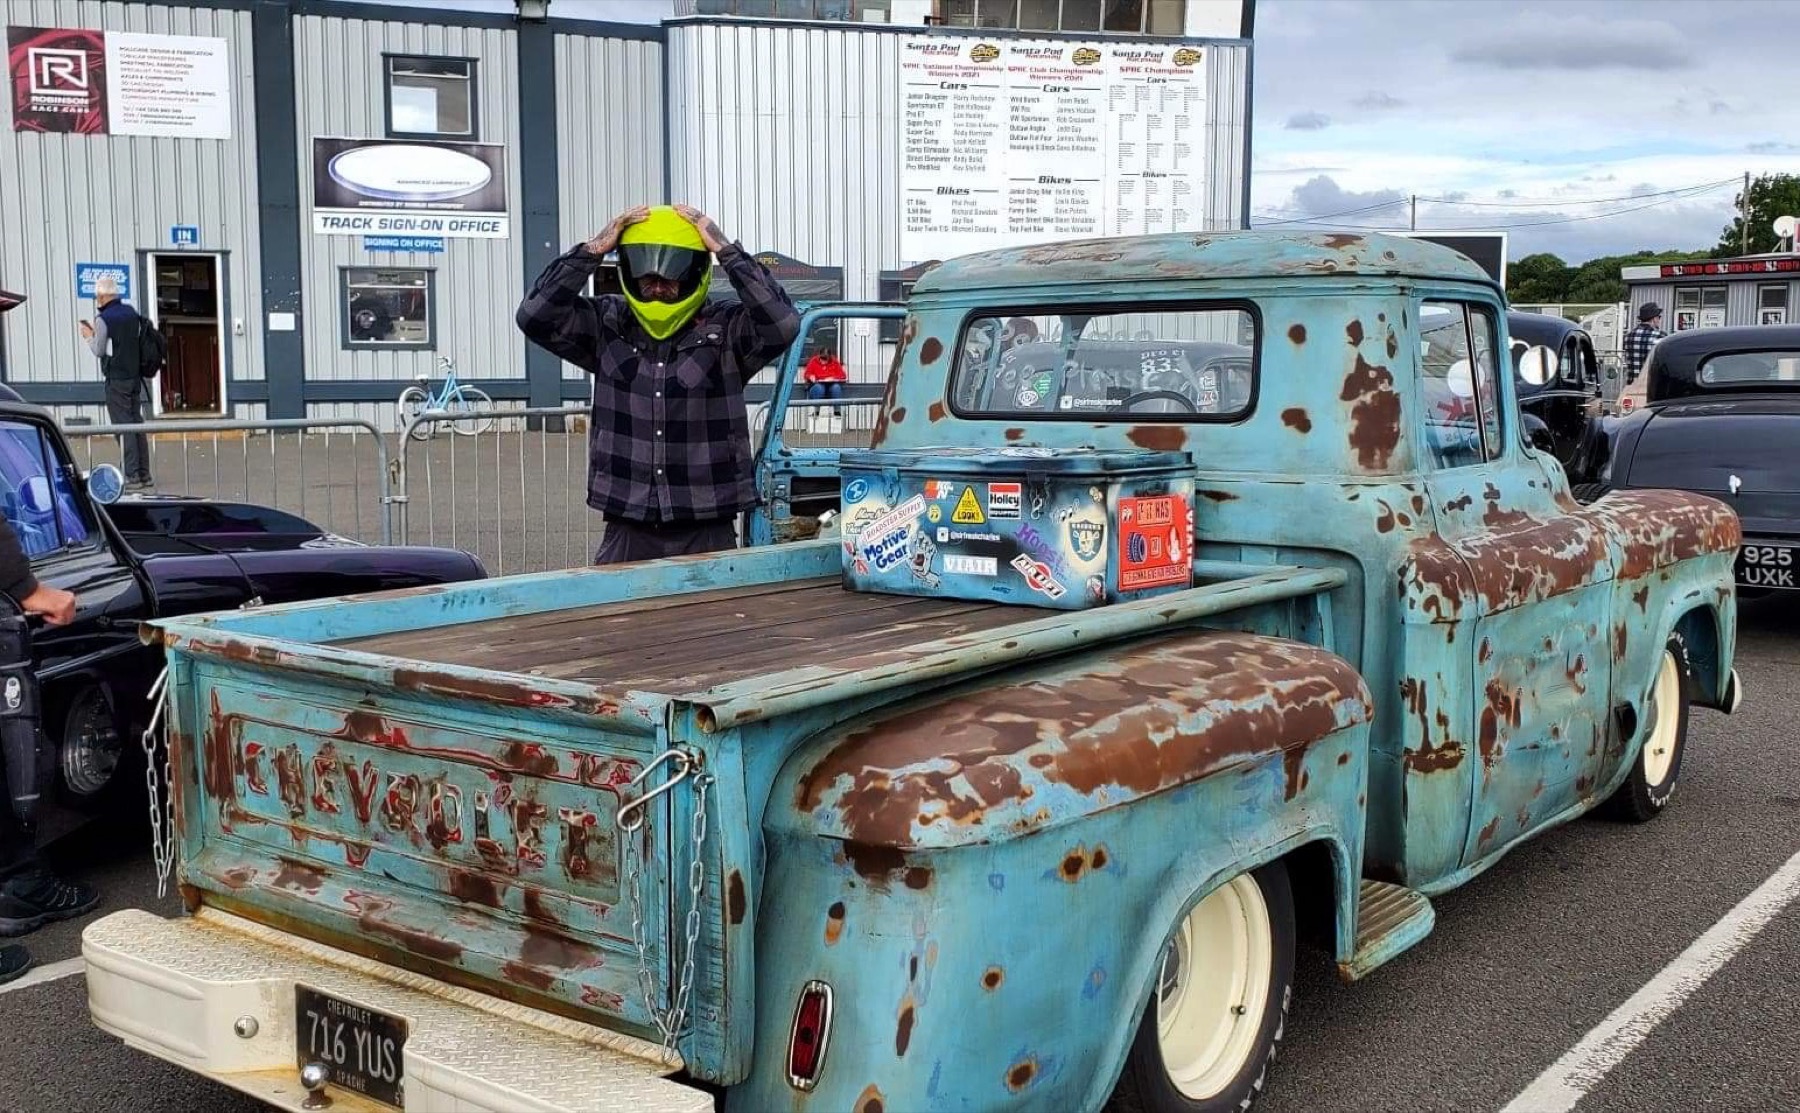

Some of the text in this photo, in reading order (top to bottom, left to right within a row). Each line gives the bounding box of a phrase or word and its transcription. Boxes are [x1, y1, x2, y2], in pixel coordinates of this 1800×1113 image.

[906, 43, 960, 52] Santa Pod
[940, 82, 968, 90] Cars
[1043, 84, 1070, 92] Cars
[31, 96, 89, 105] ROBINSON
[937, 186, 970, 195] Bikes
[322, 217, 500, 232] TRACK SIGN-ON OFFICE
[178, 230, 192, 241] IN
[366, 237, 442, 249] SIGNING ON OFFICE
[990, 493, 1019, 506] Holley
[1155, 501, 1170, 518] HAS
[866, 513, 899, 540] ROADSTER
[898, 501, 922, 522] SUPPLY
[864, 528, 908, 562] Motive
[876, 545, 908, 569] Gear
[1744, 546, 1793, 566] 925
[1745, 567, 1794, 586] UXK
[244, 742, 598, 874] CHEVROLET
[327, 1000, 372, 1024] CHEVROLET
[307, 1010, 396, 1084] 716 YUS
[336, 1070, 366, 1092] APACHE
